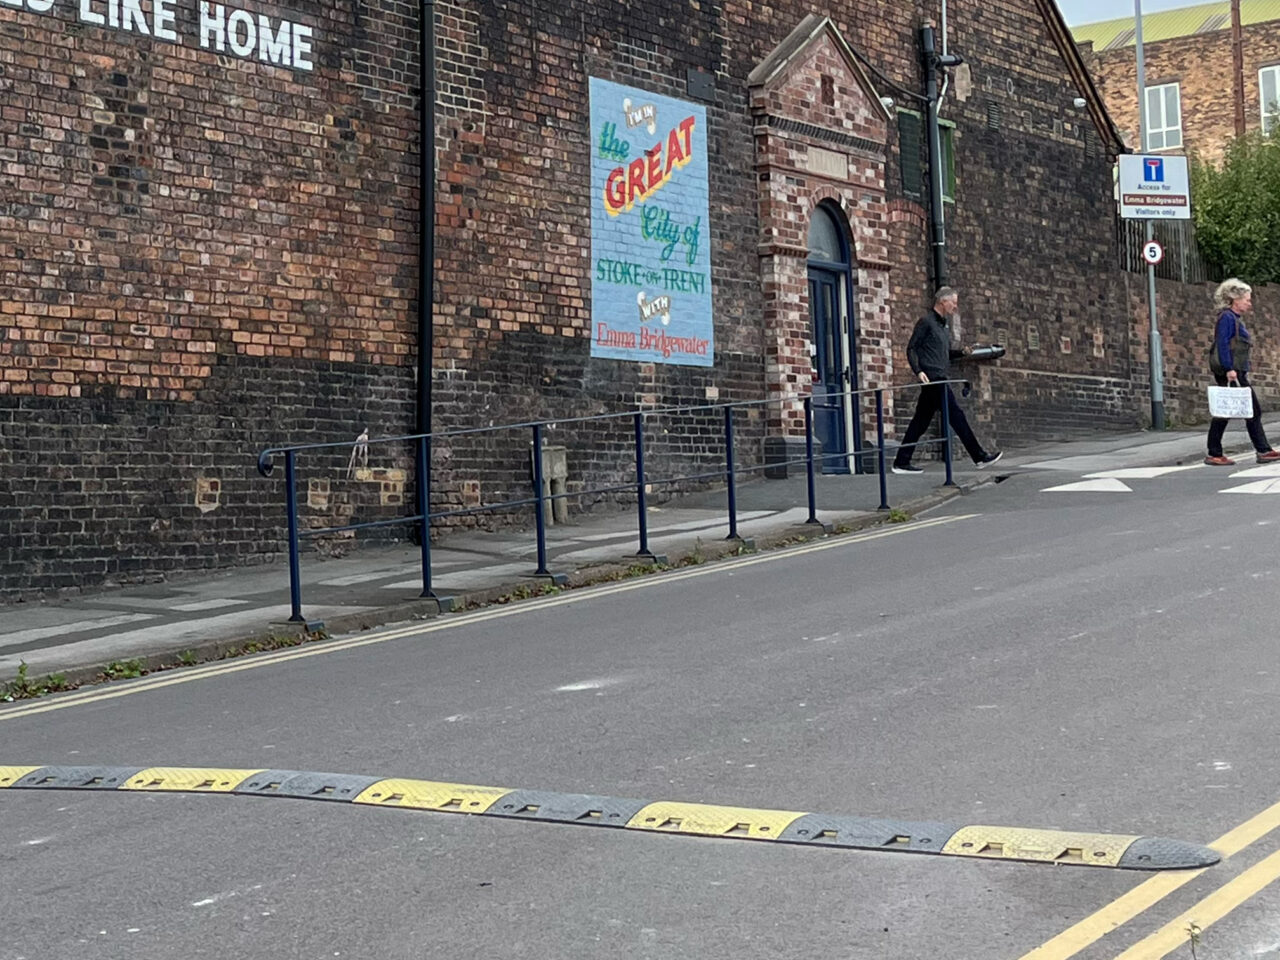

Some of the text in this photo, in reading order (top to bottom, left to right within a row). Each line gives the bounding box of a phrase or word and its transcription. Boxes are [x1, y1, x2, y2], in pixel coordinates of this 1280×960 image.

[199, 0, 315, 71] HOME
[600, 121, 630, 162] the
[604, 115, 696, 214] GREAT
[1124, 195, 1185, 205] Emma Bridgewater
[641, 204, 701, 266] City of
[1149, 247, 1157, 258] 5
[641, 296, 668, 318] WITH
[596, 322, 710, 358] Emma Bridgewater
